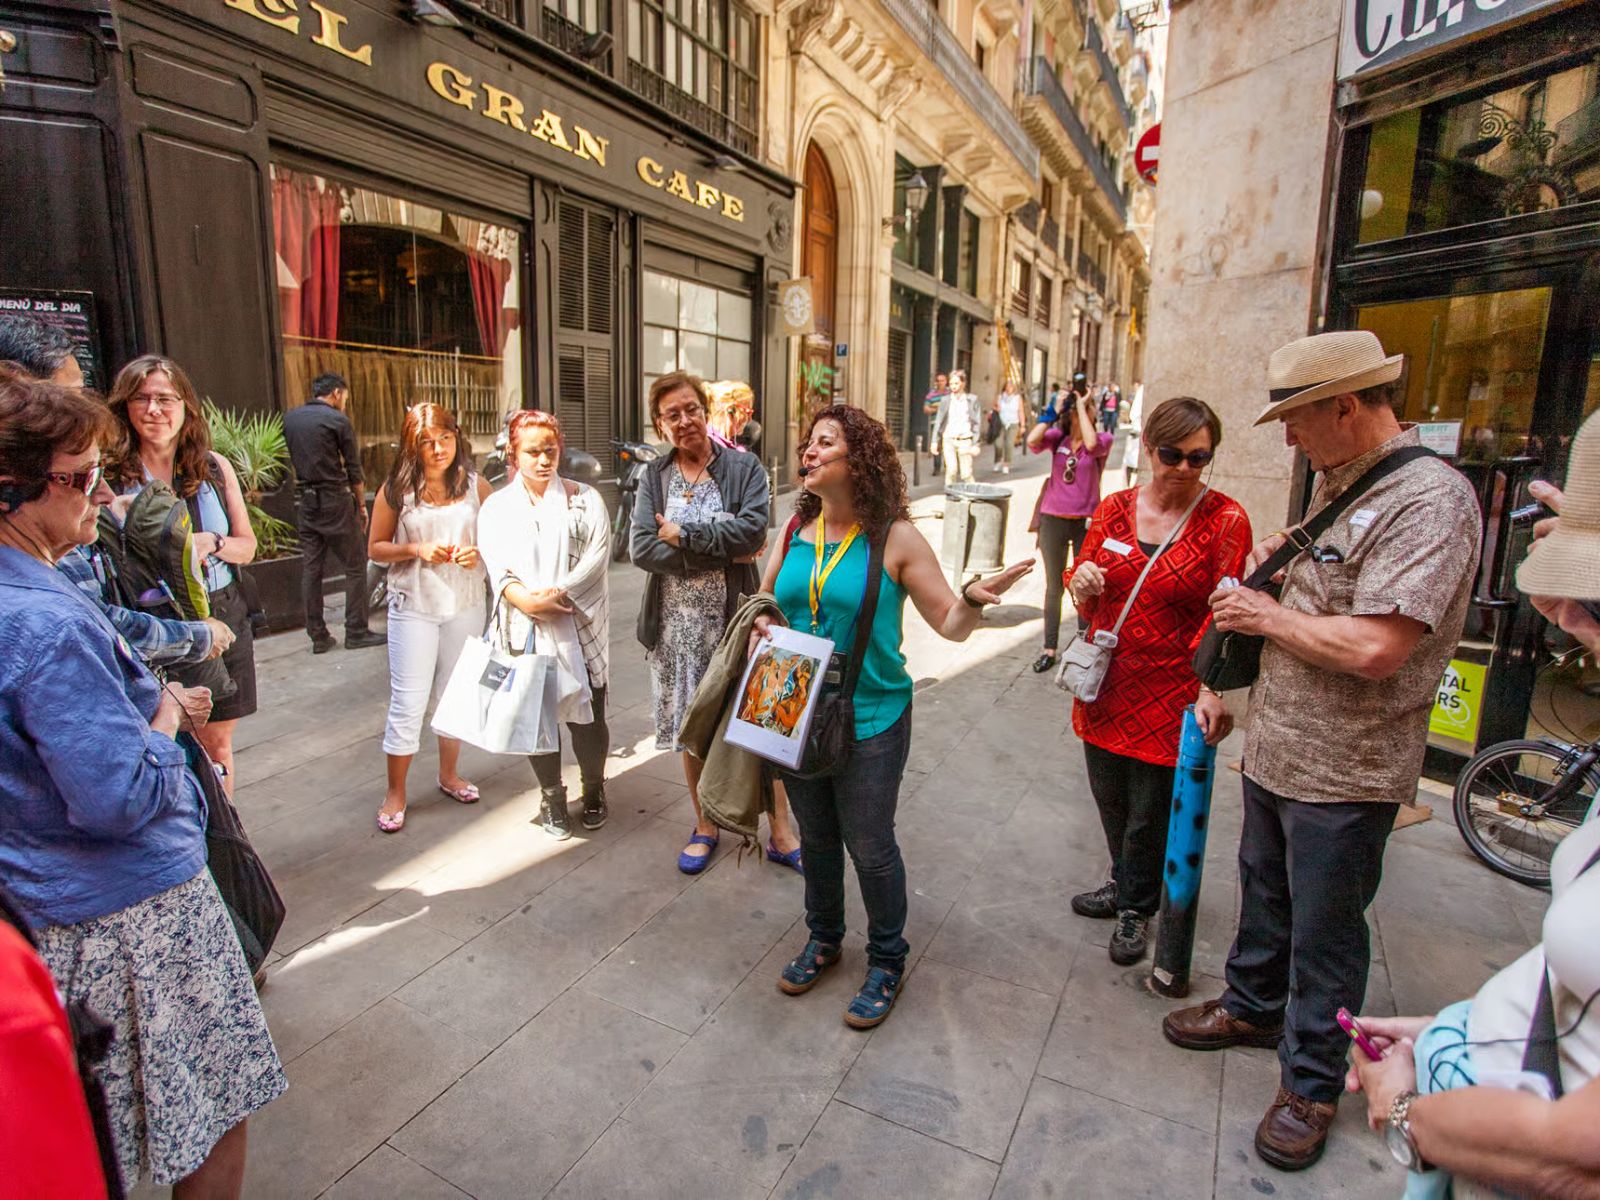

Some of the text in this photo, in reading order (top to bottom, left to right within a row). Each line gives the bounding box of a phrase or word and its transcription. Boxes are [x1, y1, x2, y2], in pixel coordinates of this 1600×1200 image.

[426, 62, 610, 167] GRAN
[636, 156, 744, 222] CAFE
[35, 301, 58, 311] DEL
